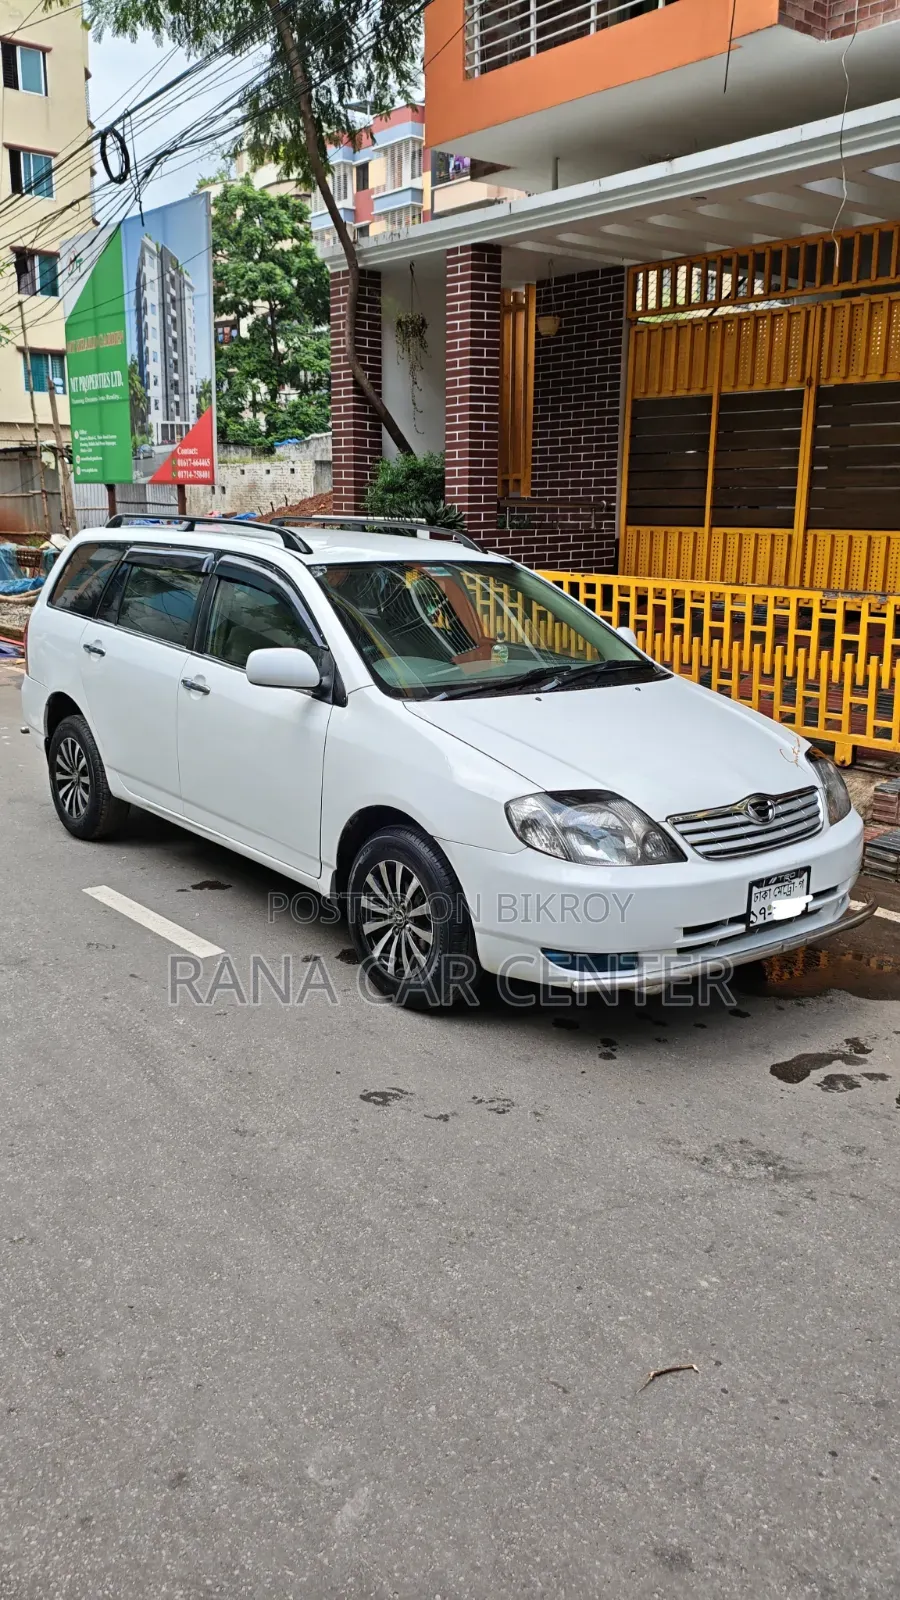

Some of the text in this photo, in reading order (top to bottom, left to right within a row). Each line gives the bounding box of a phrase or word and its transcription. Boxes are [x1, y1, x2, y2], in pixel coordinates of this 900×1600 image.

[79, 371, 111, 392] PROPERTIES
[110, 370, 124, 387] LTD.
[177, 447, 199, 455] Contact:
[753, 888, 771, 903] ঢাকা
